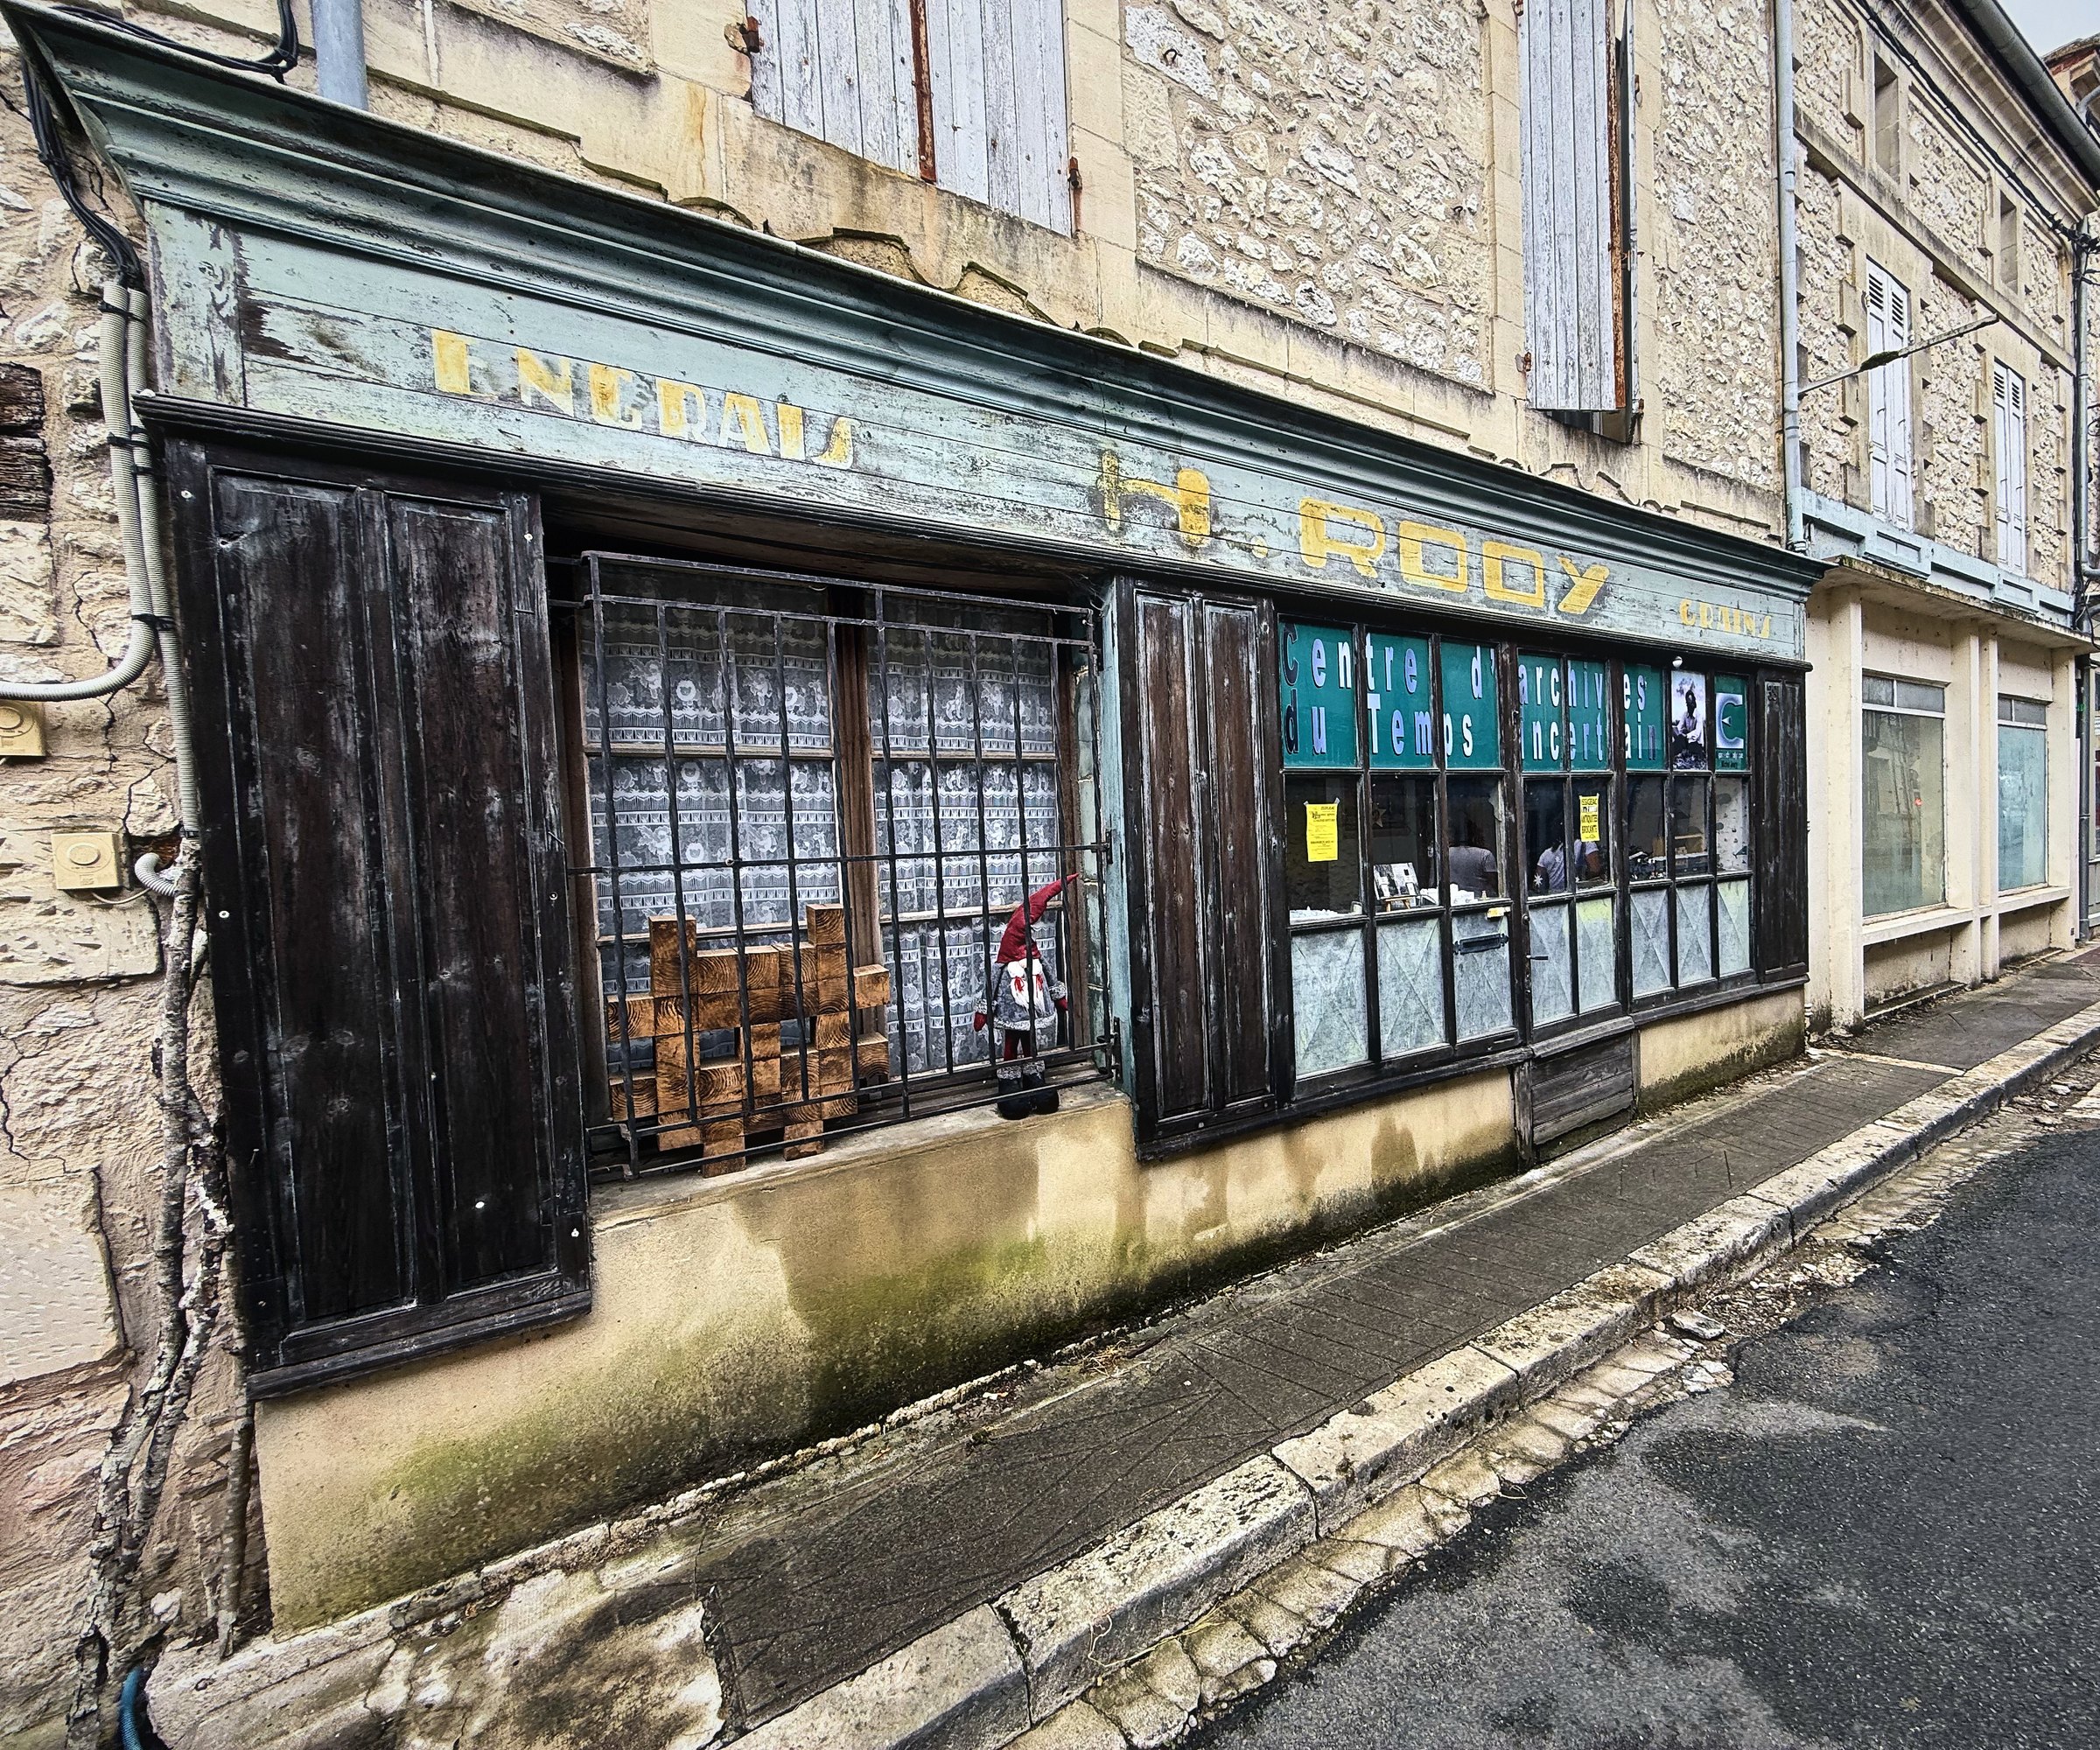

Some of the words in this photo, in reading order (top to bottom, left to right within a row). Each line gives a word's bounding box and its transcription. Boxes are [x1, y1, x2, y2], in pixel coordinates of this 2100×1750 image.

[430, 328, 862, 470] ENGRAIS
[1298, 497, 1610, 615] ROOY
[1679, 597, 1772, 639] GRAINS
[1282, 622, 1418, 694] Centre
[1284, 688, 1326, 755] du
[1367, 692, 1474, 767] Temps
